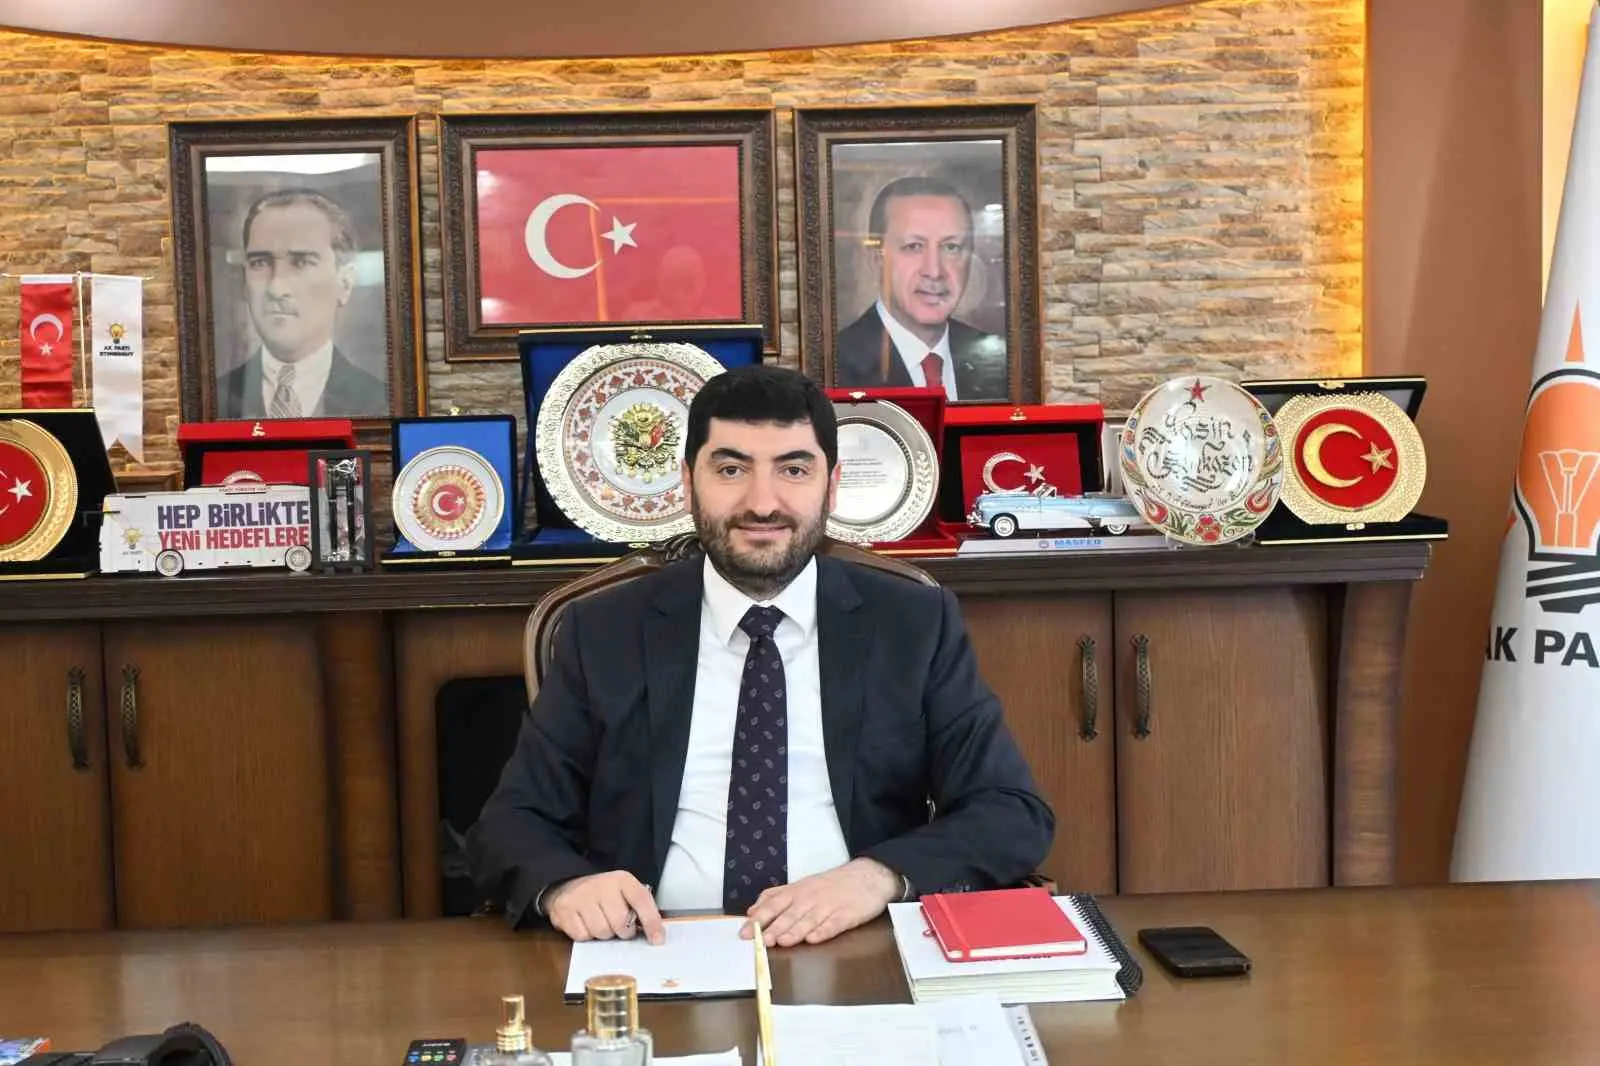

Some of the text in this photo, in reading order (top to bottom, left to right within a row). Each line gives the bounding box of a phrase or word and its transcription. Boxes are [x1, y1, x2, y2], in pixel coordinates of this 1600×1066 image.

[157, 504, 200, 530] HEP
[206, 526, 309, 550] HEDEFLERE
[1534, 629, 1600, 668] PA
